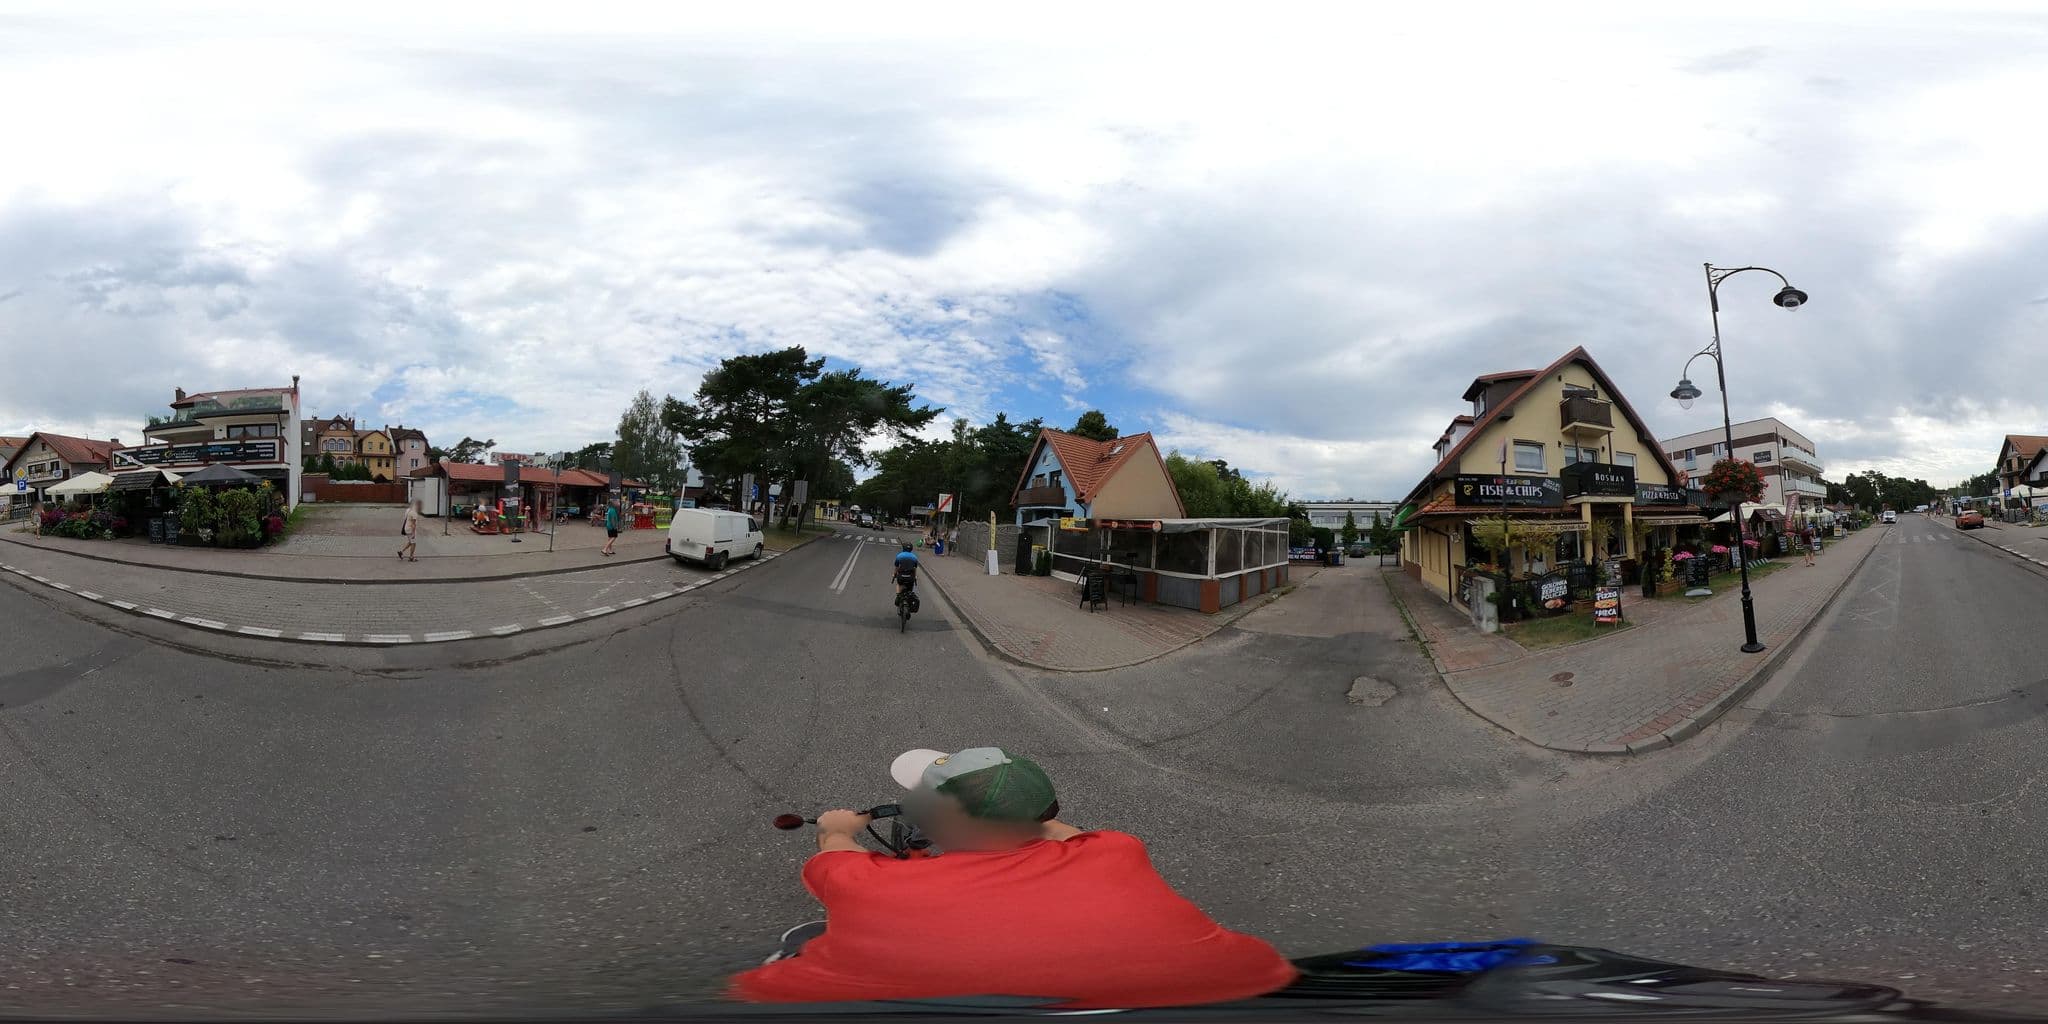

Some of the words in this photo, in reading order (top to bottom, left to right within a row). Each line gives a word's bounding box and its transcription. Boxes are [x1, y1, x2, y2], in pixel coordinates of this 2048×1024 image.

[1595, 472, 1624, 482] BOSMAN
[19, 481, 25, 490] P
[1505, 485, 1515, 496] &
[1515, 485, 1543, 498] CHIPS
[1642, 490, 1658, 500] PIZZA
[1663, 490, 1679, 500] PASTA
